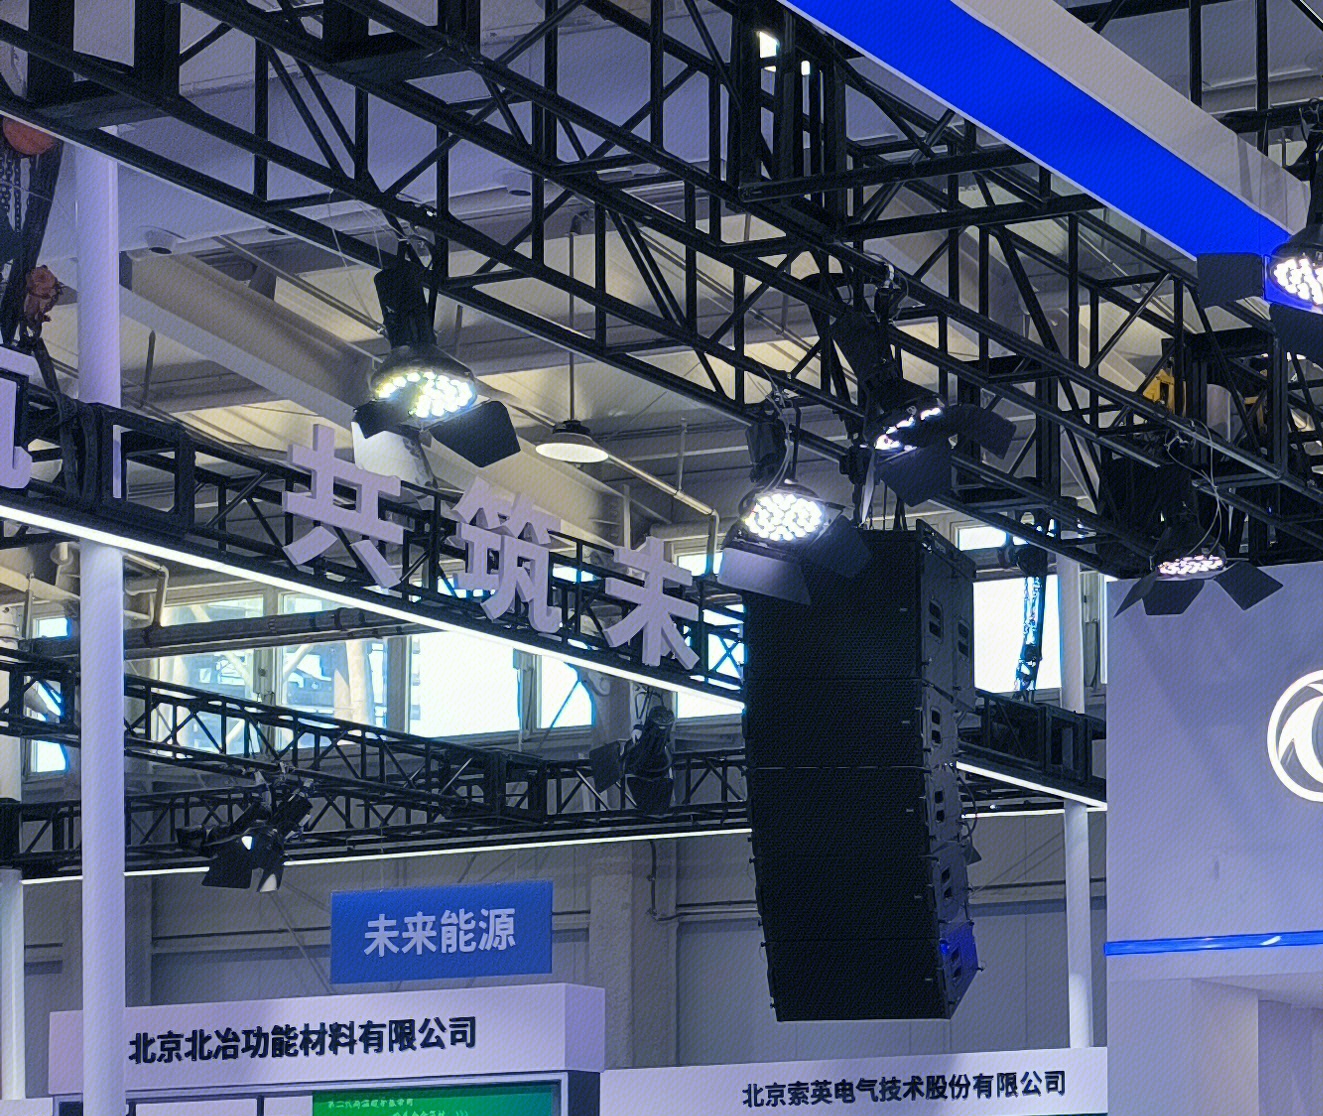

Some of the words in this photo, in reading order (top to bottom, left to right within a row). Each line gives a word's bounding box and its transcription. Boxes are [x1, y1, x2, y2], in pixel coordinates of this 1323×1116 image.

[363, 909, 517, 957] 未来能源
[127, 1016, 477, 1064] 北京北冶功能材料有限公司
[742, 1070, 1067, 1108] 北京索英电气技术股份有限公司
